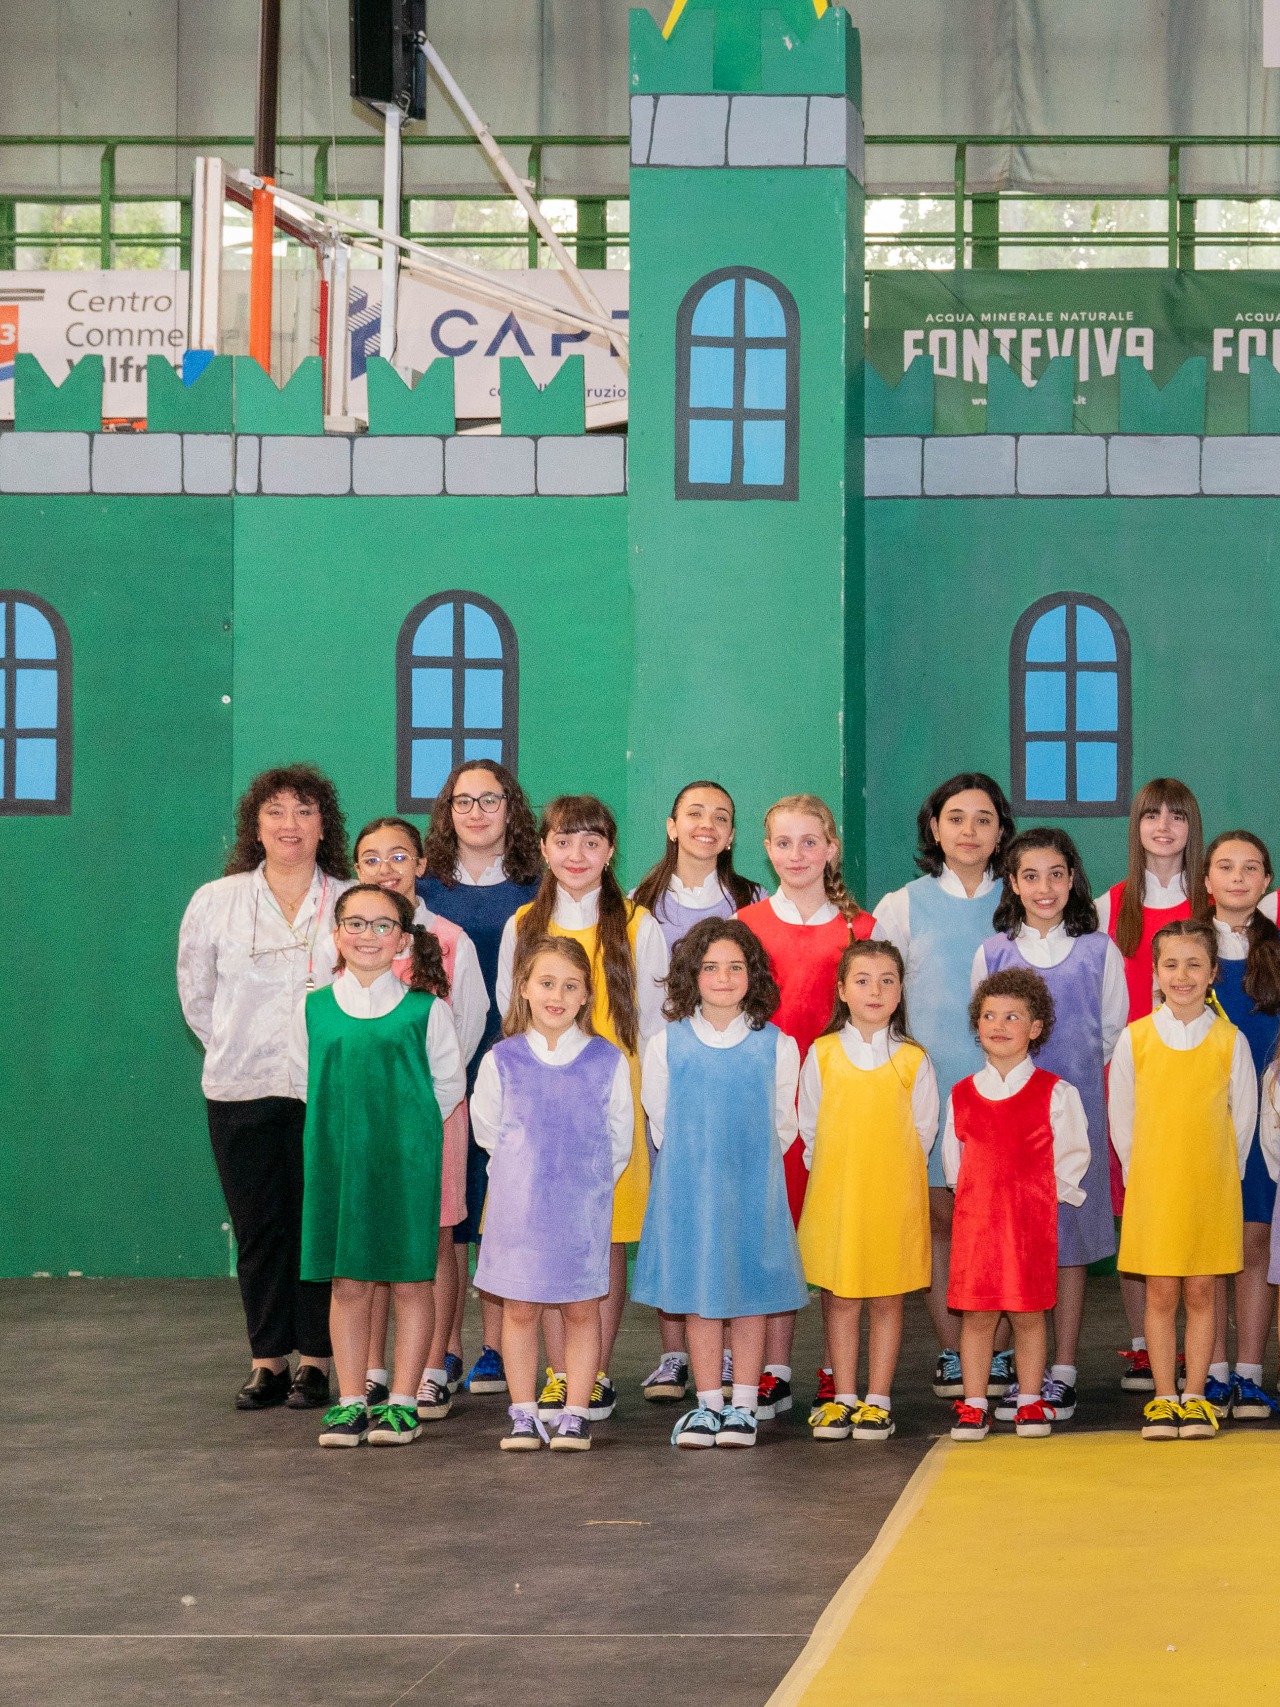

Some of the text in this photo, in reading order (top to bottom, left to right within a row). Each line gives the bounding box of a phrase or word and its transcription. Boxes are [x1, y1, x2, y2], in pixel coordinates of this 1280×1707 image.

[67, 289, 173, 313] Centro
[925, 311, 1134, 322] ACQUA MINERALE NATURALE
[903, 327, 1154, 388] FONTEVIVA
